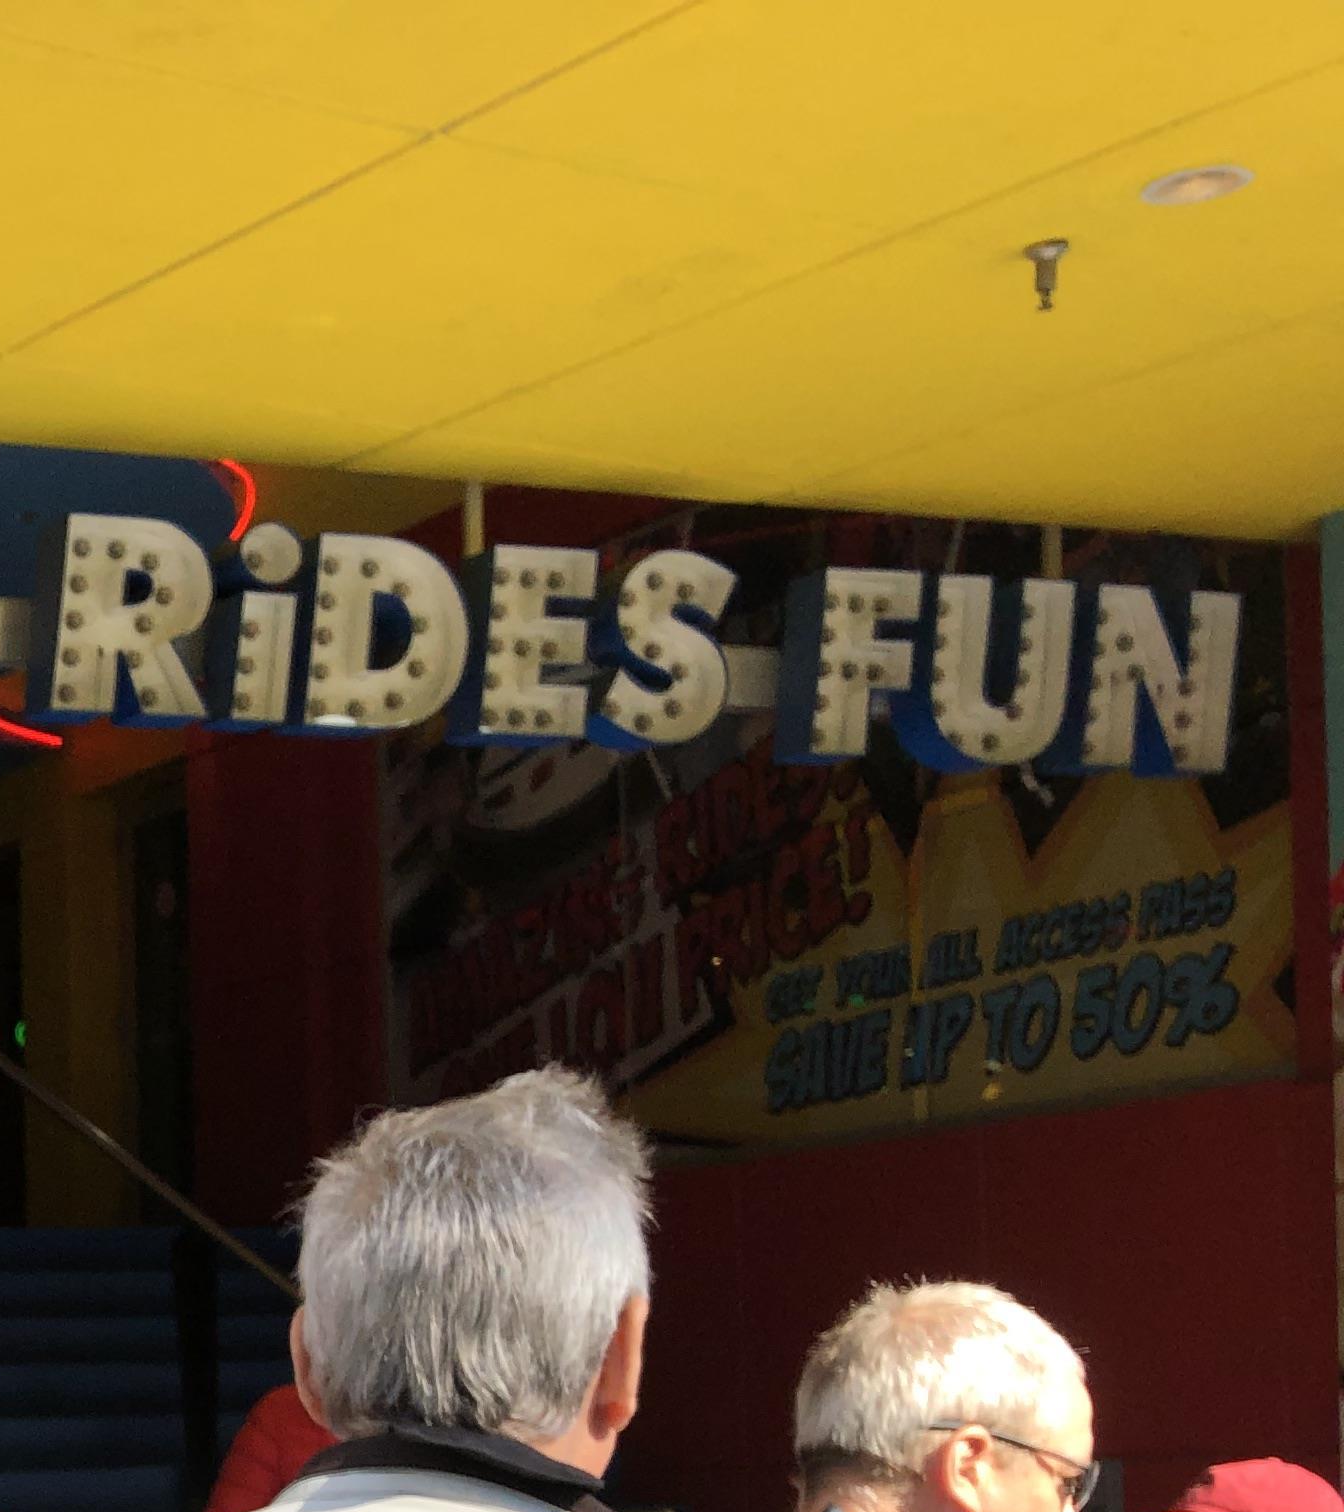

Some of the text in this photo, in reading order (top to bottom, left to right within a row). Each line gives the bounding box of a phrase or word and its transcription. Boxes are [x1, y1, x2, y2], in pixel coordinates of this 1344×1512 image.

[800, 566, 1244, 773] FUN
[921, 926, 983, 990] ALL
[994, 890, 1132, 974] ACCESS
[766, 1009, 892, 1114] SAVE
[983, 972, 1061, 1073] TO
[1070, 942, 1239, 1060] 50%
